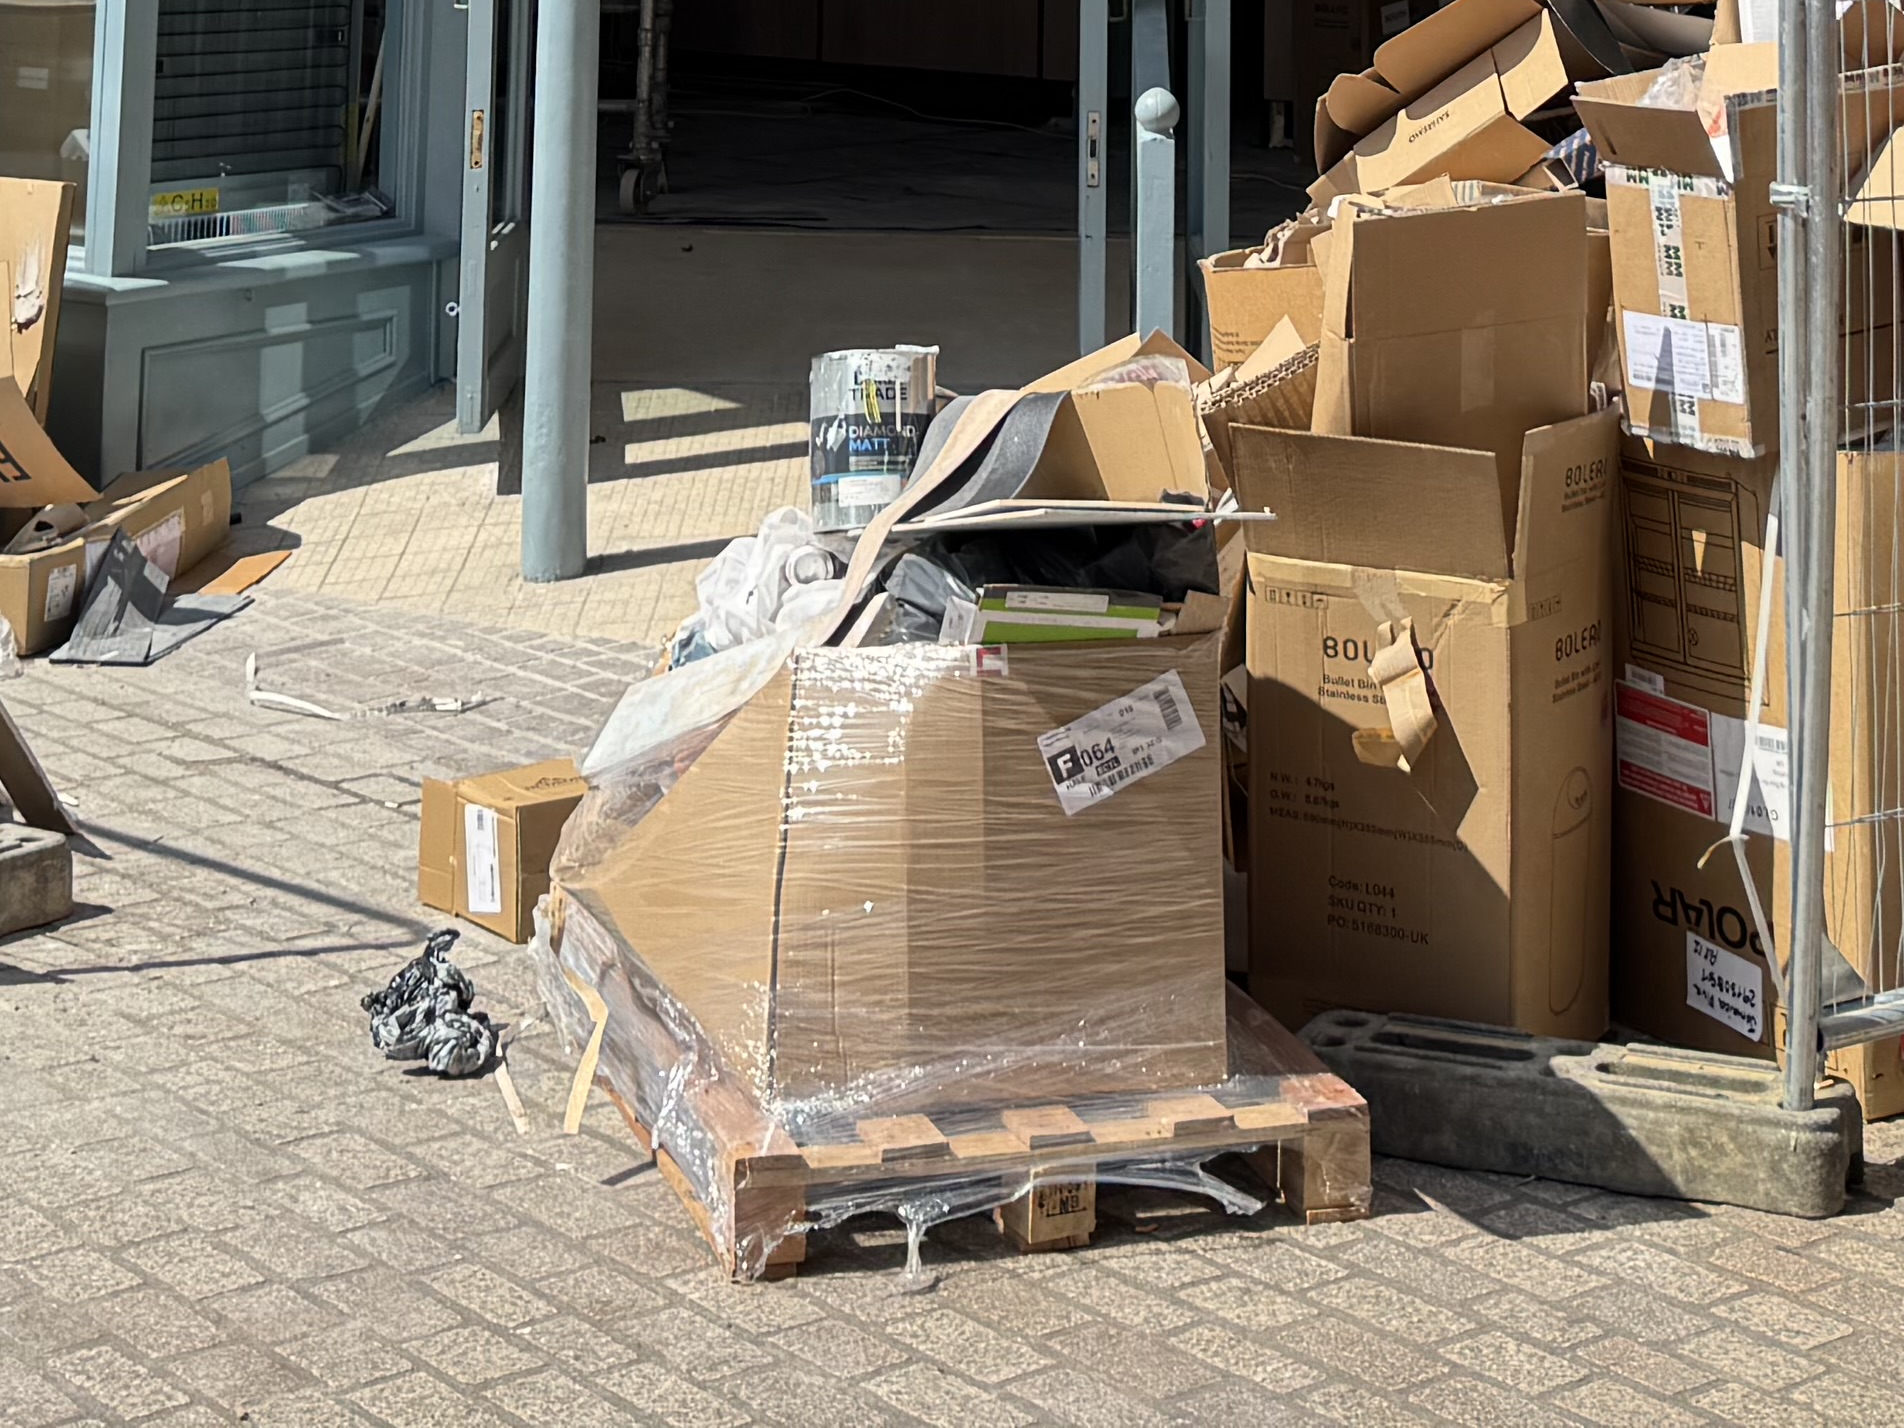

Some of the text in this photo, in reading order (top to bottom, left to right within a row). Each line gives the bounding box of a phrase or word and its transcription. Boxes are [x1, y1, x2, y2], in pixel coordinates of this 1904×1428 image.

[848, 437, 891, 452] MATT
[1322, 636, 1435, 671] BOLO
[1322, 673, 1378, 691] Bullet Bin
[1317, 685, 1371, 705] Stainless
[1080, 736, 1116, 768] 064
[1328, 875, 1395, 899] Code: L044
[1328, 894, 1354, 911] SKU
[1357, 901, 1387, 918] QTY:
[1327, 913, 1350, 930] PO:
